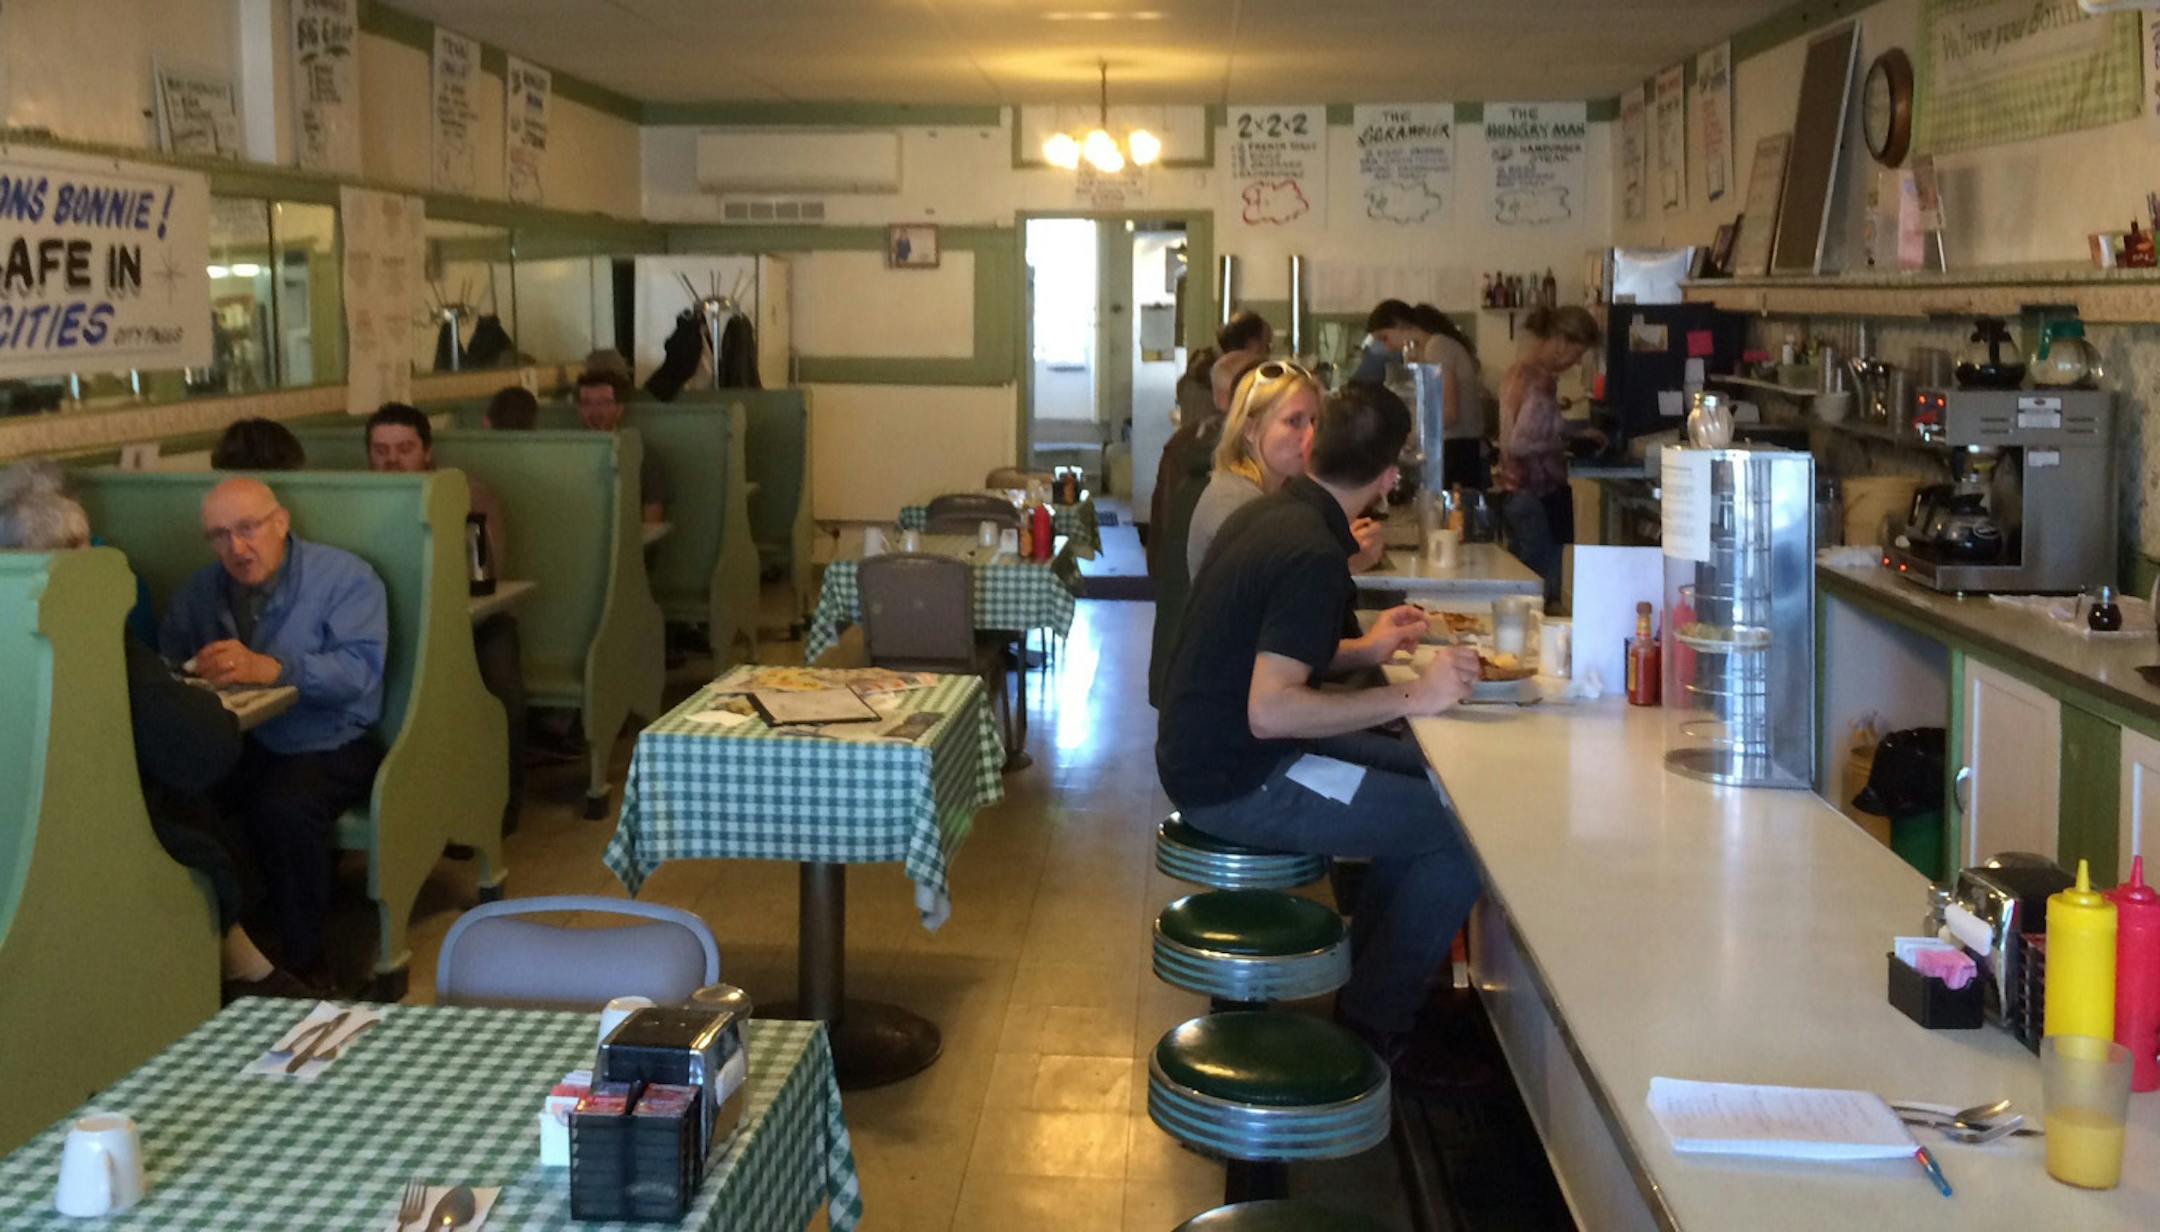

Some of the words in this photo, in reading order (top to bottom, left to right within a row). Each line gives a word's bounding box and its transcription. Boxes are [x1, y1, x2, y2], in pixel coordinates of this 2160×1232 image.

[1383, 109, 1410, 122] THE
[1508, 107, 1538, 120] THE
[1552, 123, 1585, 138] MAN
[0, 237, 93, 292] AFE
[108, 242, 142, 290] IN
